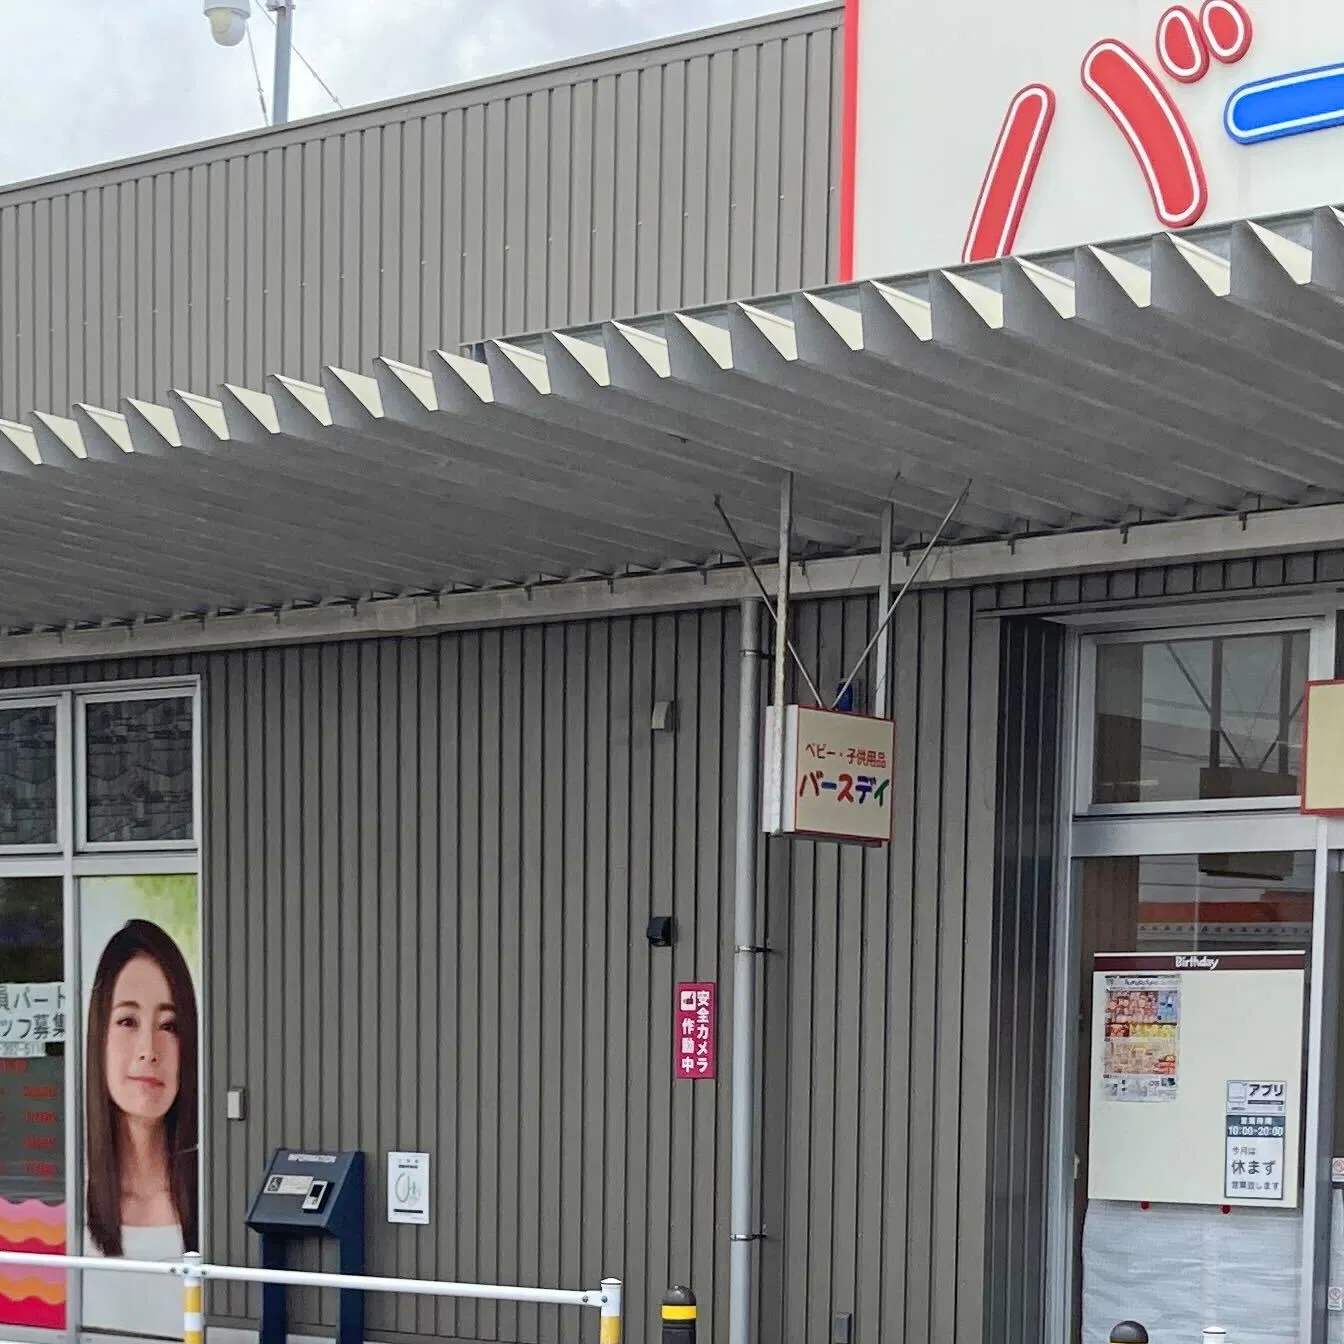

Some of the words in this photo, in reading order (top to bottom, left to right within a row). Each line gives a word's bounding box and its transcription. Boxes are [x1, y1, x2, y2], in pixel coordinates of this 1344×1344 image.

[805, 743, 887, 769] ベビー・子供用品
[798, 770, 891, 808] バースデイ
[1175, 955, 1220, 970] Birthday
[696, 989, 710, 1073] 安全カメラ
[1248, 1083, 1284, 1097] アプリ
[1231, 1159, 1276, 1176] 休まず
